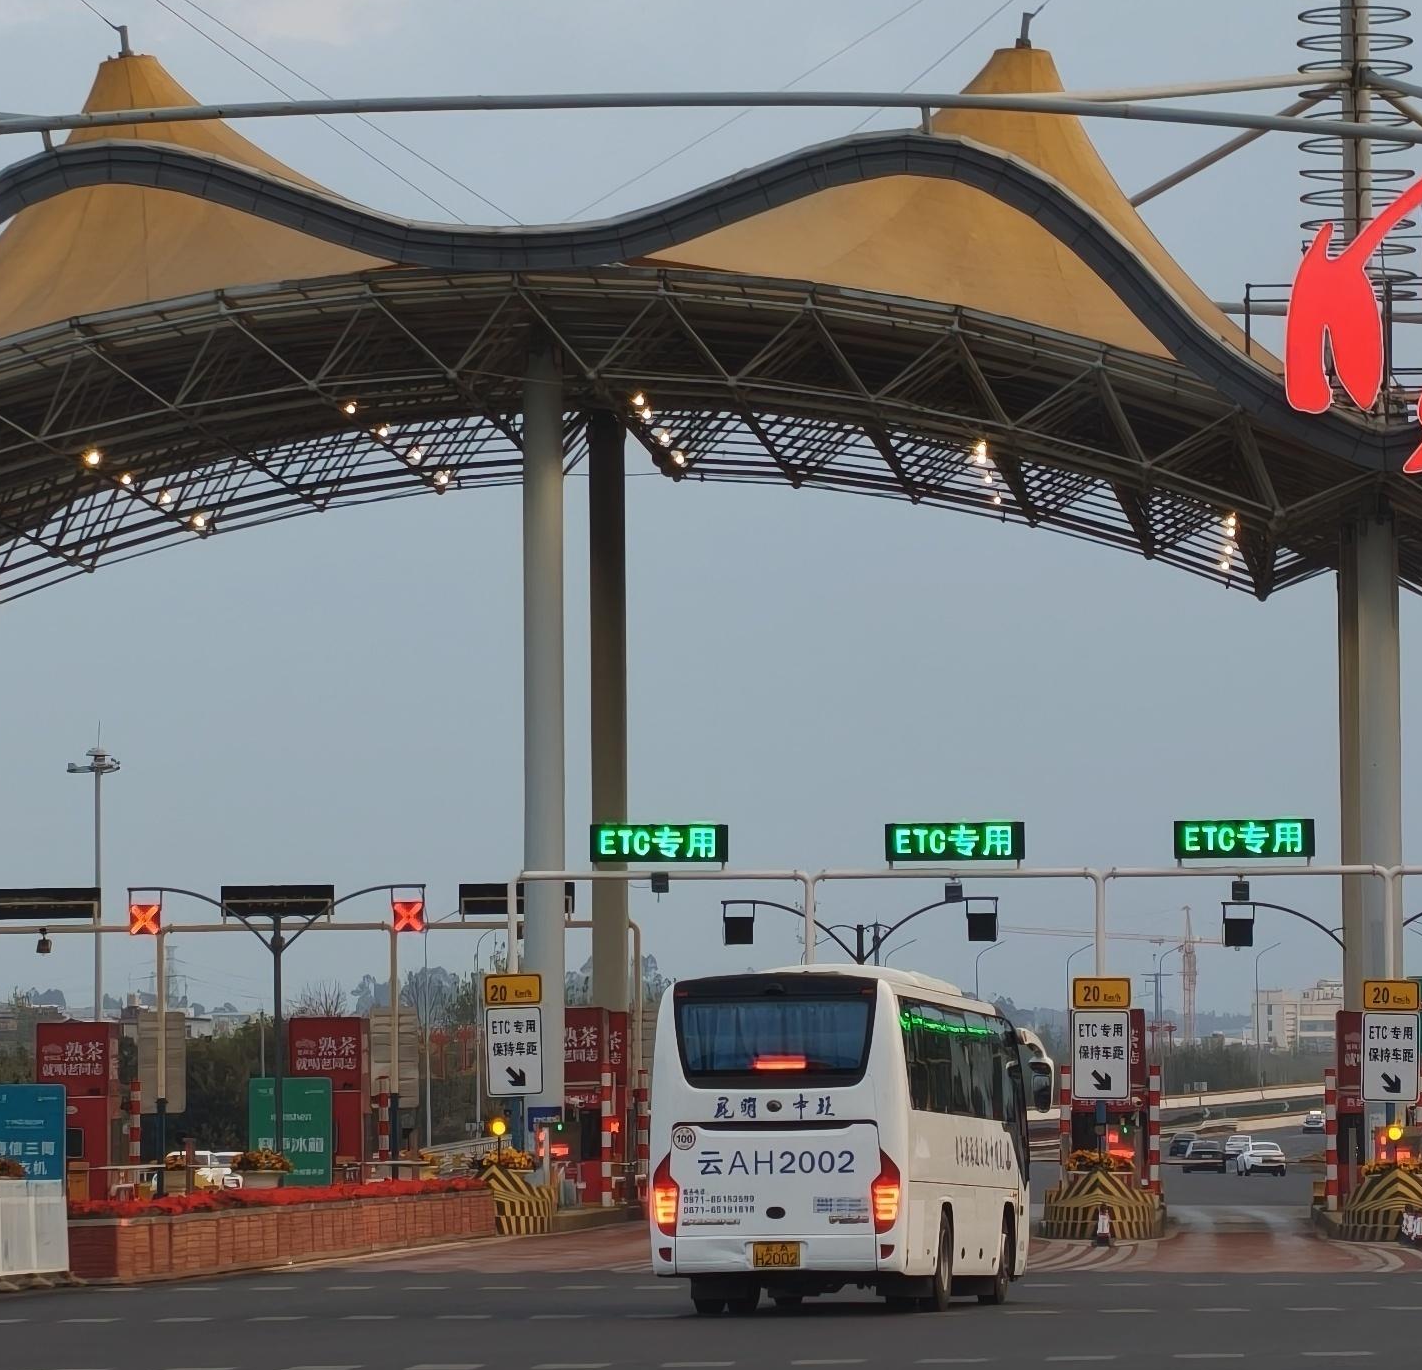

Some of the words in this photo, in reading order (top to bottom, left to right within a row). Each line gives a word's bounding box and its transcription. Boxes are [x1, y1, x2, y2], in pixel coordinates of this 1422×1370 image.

[599, 826, 717, 857] ETC专用
[894, 824, 1012, 856] ETC专用
[1183, 821, 1303, 853] ETC专用
[490, 985, 507, 1001] 20
[1083, 986, 1100, 1002] 20
[1373, 987, 1390, 1004] 20
[492, 1021, 510, 1034] ETC
[513, 1020, 536, 1033] 专用
[1078, 1024, 1098, 1037] ETC
[1100, 1024, 1123, 1037] 专用
[1369, 1026, 1387, 1040] ETC
[1391, 1026, 1413, 1040] 专用
[676, 1133, 693, 1144] 100
[697, 1150, 855, 1176] 云AH2002
[755, 1252, 798, 1266] H2002
